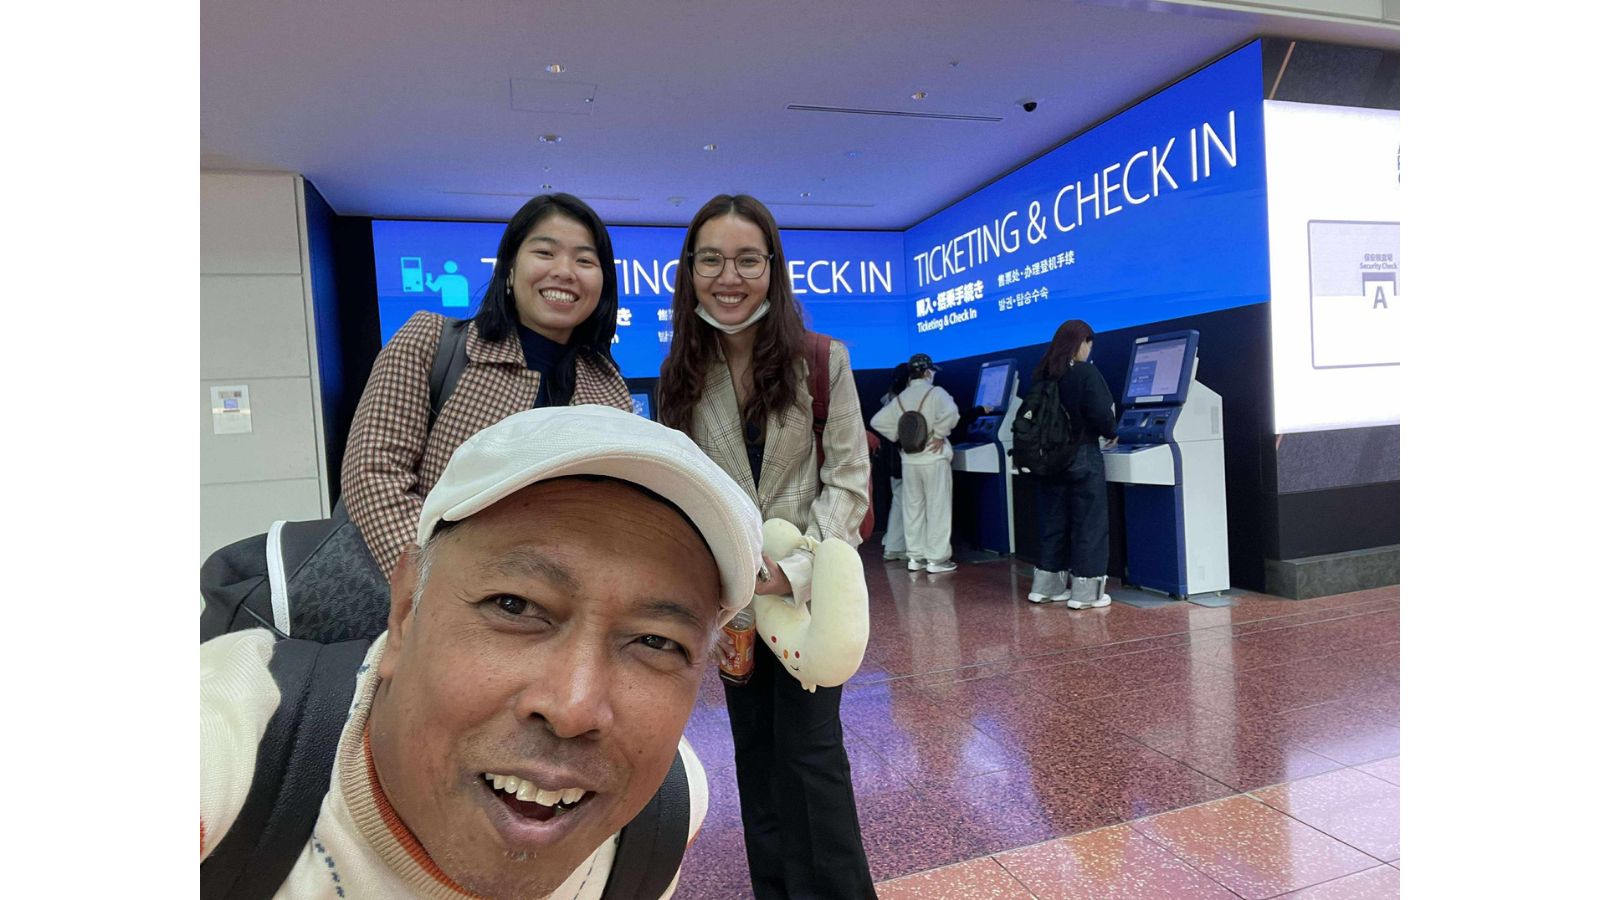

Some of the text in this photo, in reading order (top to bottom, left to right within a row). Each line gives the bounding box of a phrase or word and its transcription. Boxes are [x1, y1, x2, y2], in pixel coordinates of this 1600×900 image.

[913, 110, 1238, 287] TICKETING & CHECK IN
[787, 260, 892, 294] ECK IN
[1360, 262, 1397, 271] Security Check
[1373, 285, 1388, 309] A
[917, 307, 977, 333] Ticketing & Check In
